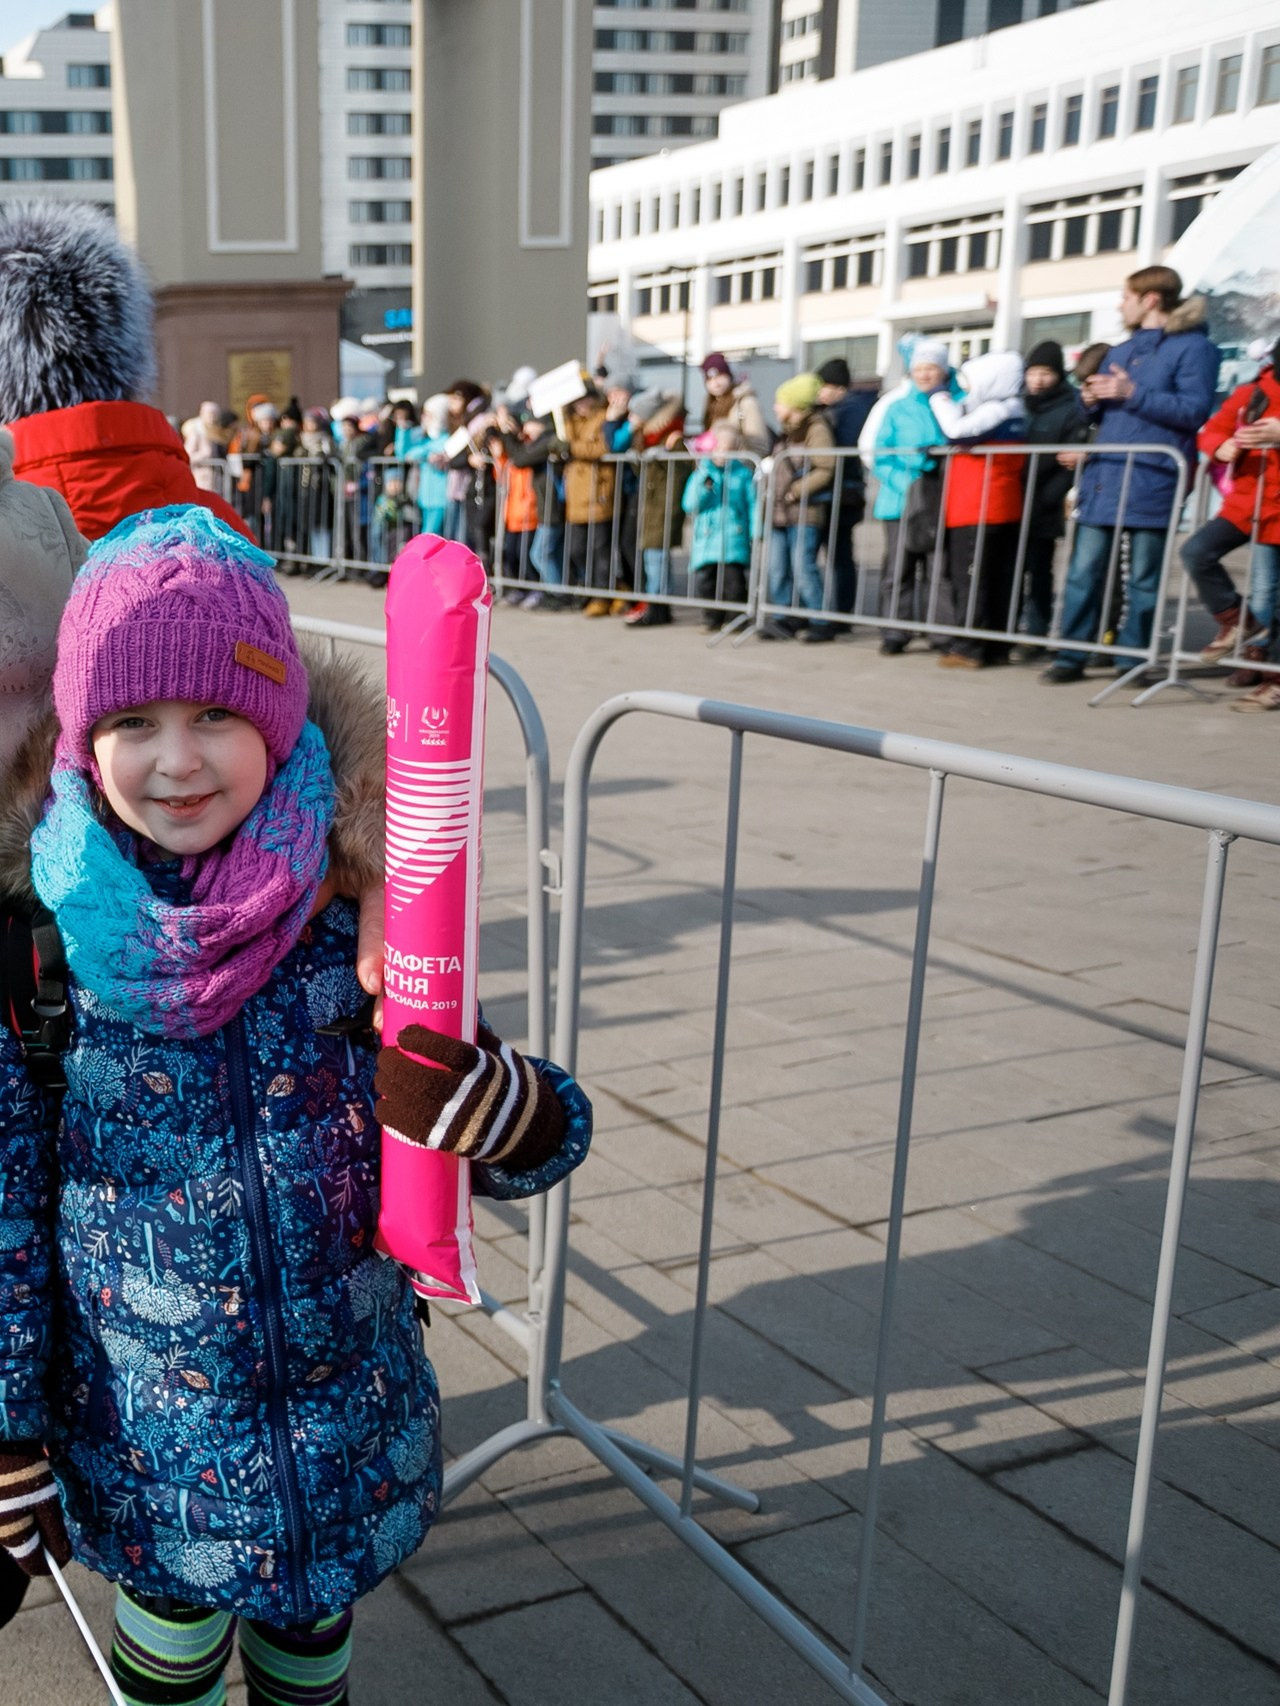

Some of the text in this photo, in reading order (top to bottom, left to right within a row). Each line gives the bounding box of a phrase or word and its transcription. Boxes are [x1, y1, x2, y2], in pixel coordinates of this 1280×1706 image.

[384, 941, 461, 974] ТАФЕТА
[384, 964, 429, 995] ОГНЯ
[432, 1000, 457, 1010] 2019
